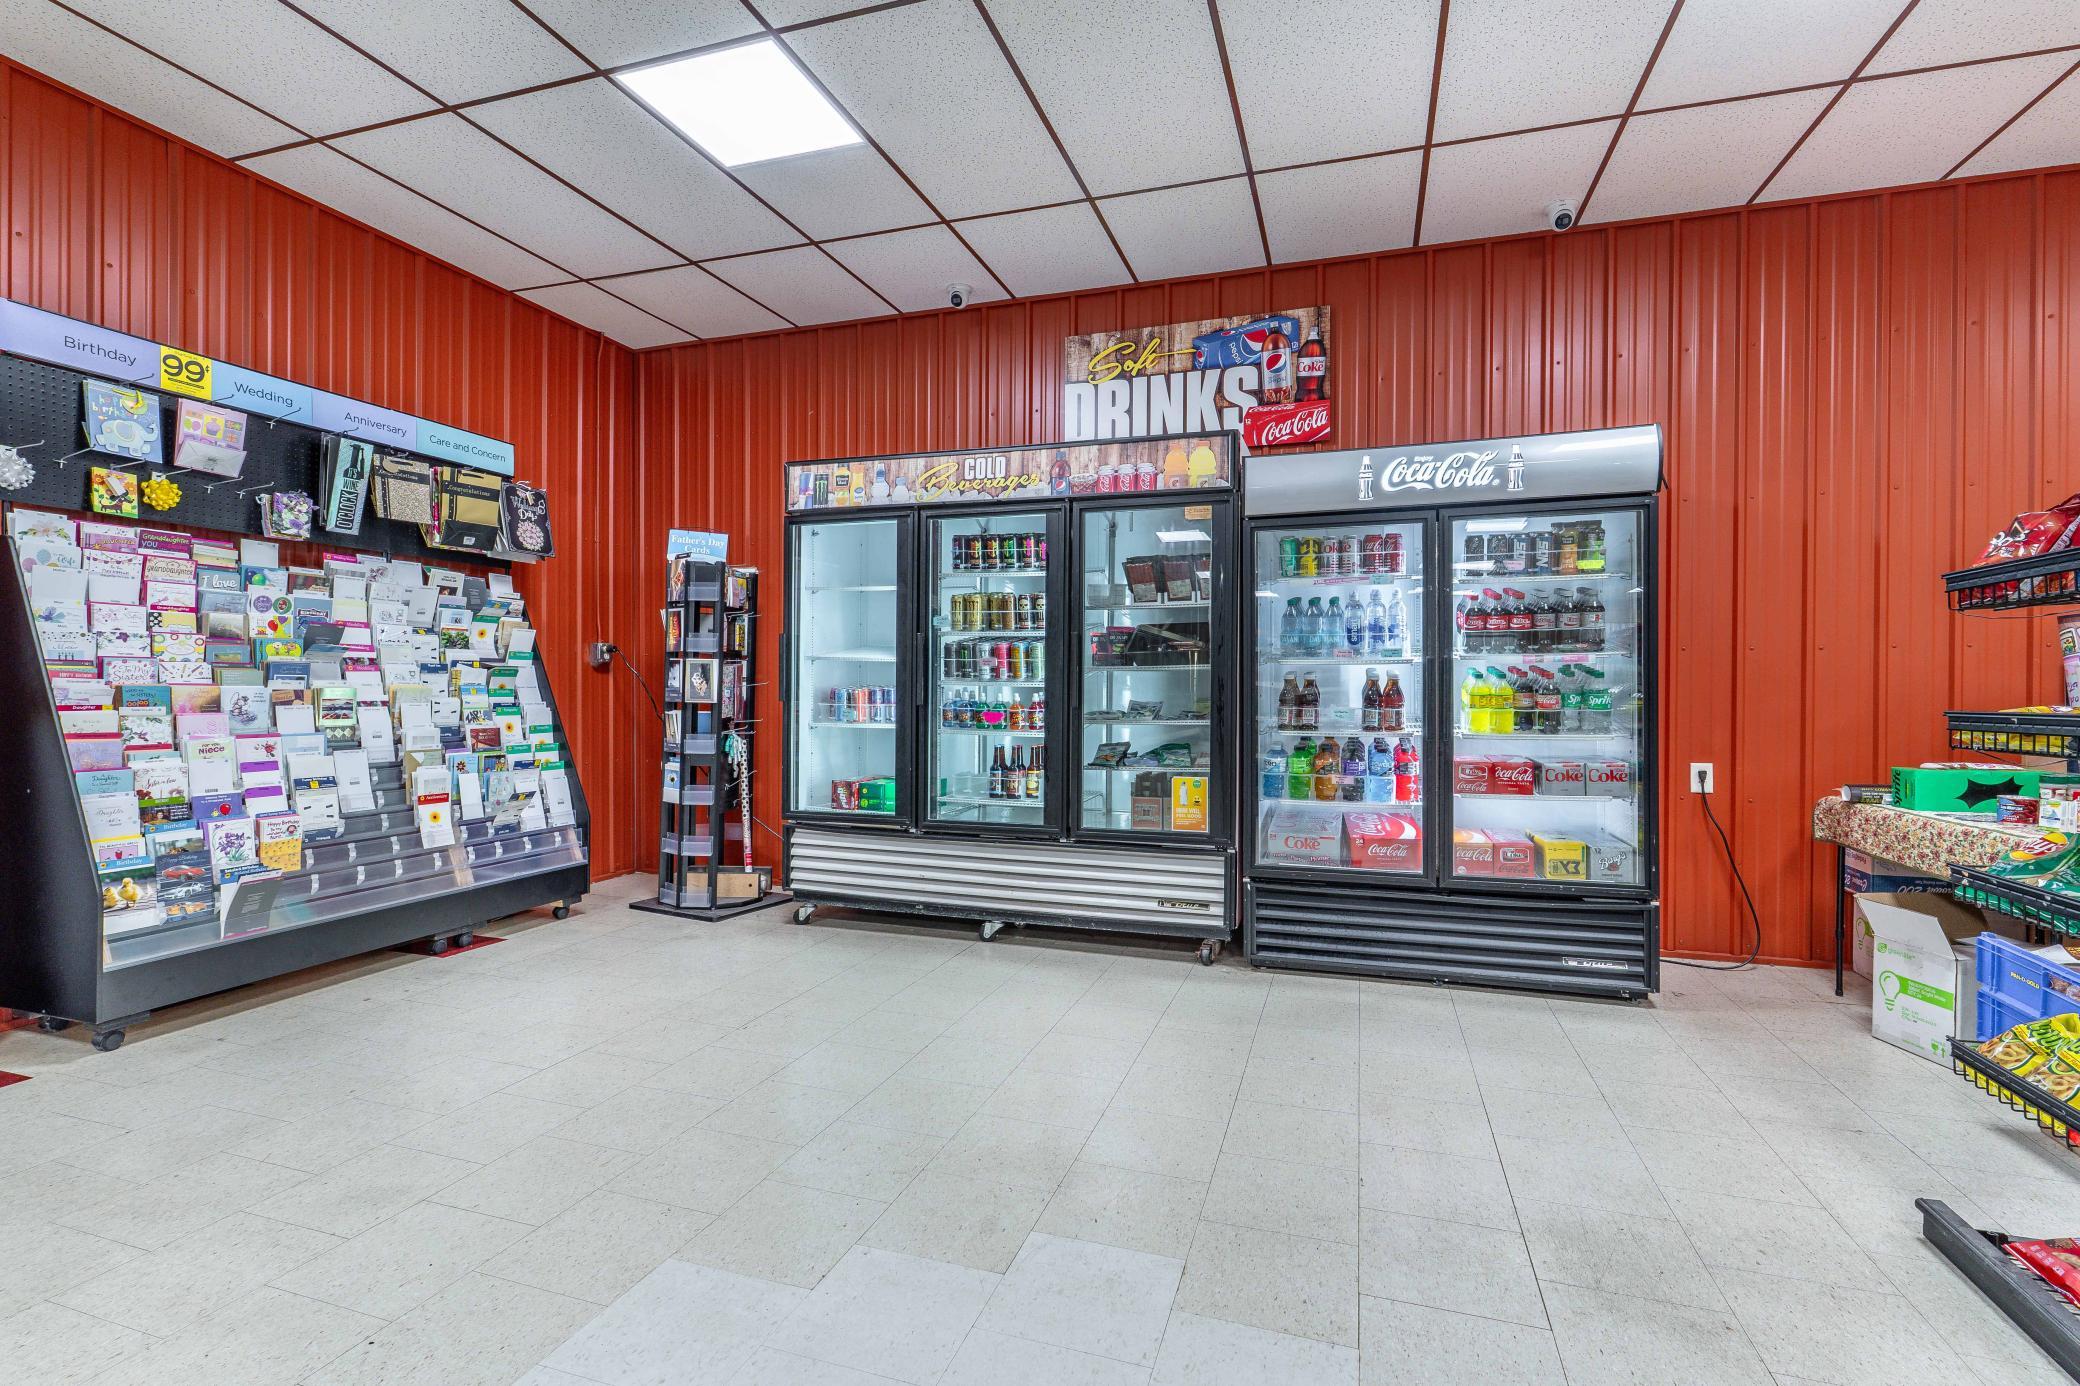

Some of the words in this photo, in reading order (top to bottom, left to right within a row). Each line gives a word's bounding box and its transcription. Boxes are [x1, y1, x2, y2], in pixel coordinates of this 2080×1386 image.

[64, 335, 137, 367] Birthday
[1229, 342, 1243, 365] pepsi
[1088, 337, 1197, 385] Soft
[1297, 361, 1324, 373] Coke
[234, 381, 294, 408] Wedding
[1064, 365, 1259, 443] DRINKS
[344, 412, 408, 438] Anniversary
[1261, 408, 1328, 445] Coca-Cola
[429, 434, 451, 449] Care
[452, 438, 470, 453] and
[471, 446, 506, 463] Concern
[964, 456, 1006, 480] COLD
[343, 477, 360, 490] WINE
[916, 461, 1040, 502] Beverages
[336, 488, 359, 530] O'CLOCK
[671, 534, 706, 546] Father's
[707, 537, 725, 549] Day
[684, 545, 710, 555] Cards
[1536, 541, 1549, 567] NOS
[212, 573, 238, 588] love
[1350, 619, 1358, 642] smart
[198, 746, 226, 756] Niece
[1545, 768, 1583, 782] Coke
[1589, 768, 1628, 782] Coke
[1457, 782, 1488, 792] Coca-Cola
[1892, 769, 1901, 806] Sprite
[426, 793, 448, 801] Anniversary
[163, 821, 187, 830] Birthday
[282, 819, 300, 827] Birthday
[1284, 835, 1321, 850] Coke
[1367, 843, 1408, 857] Coca-Cola
[116, 858, 143, 867] Birthday
[1598, 851, 1627, 870] Barq's
[2010, 971, 2041, 989] PAN-O-GOLD
